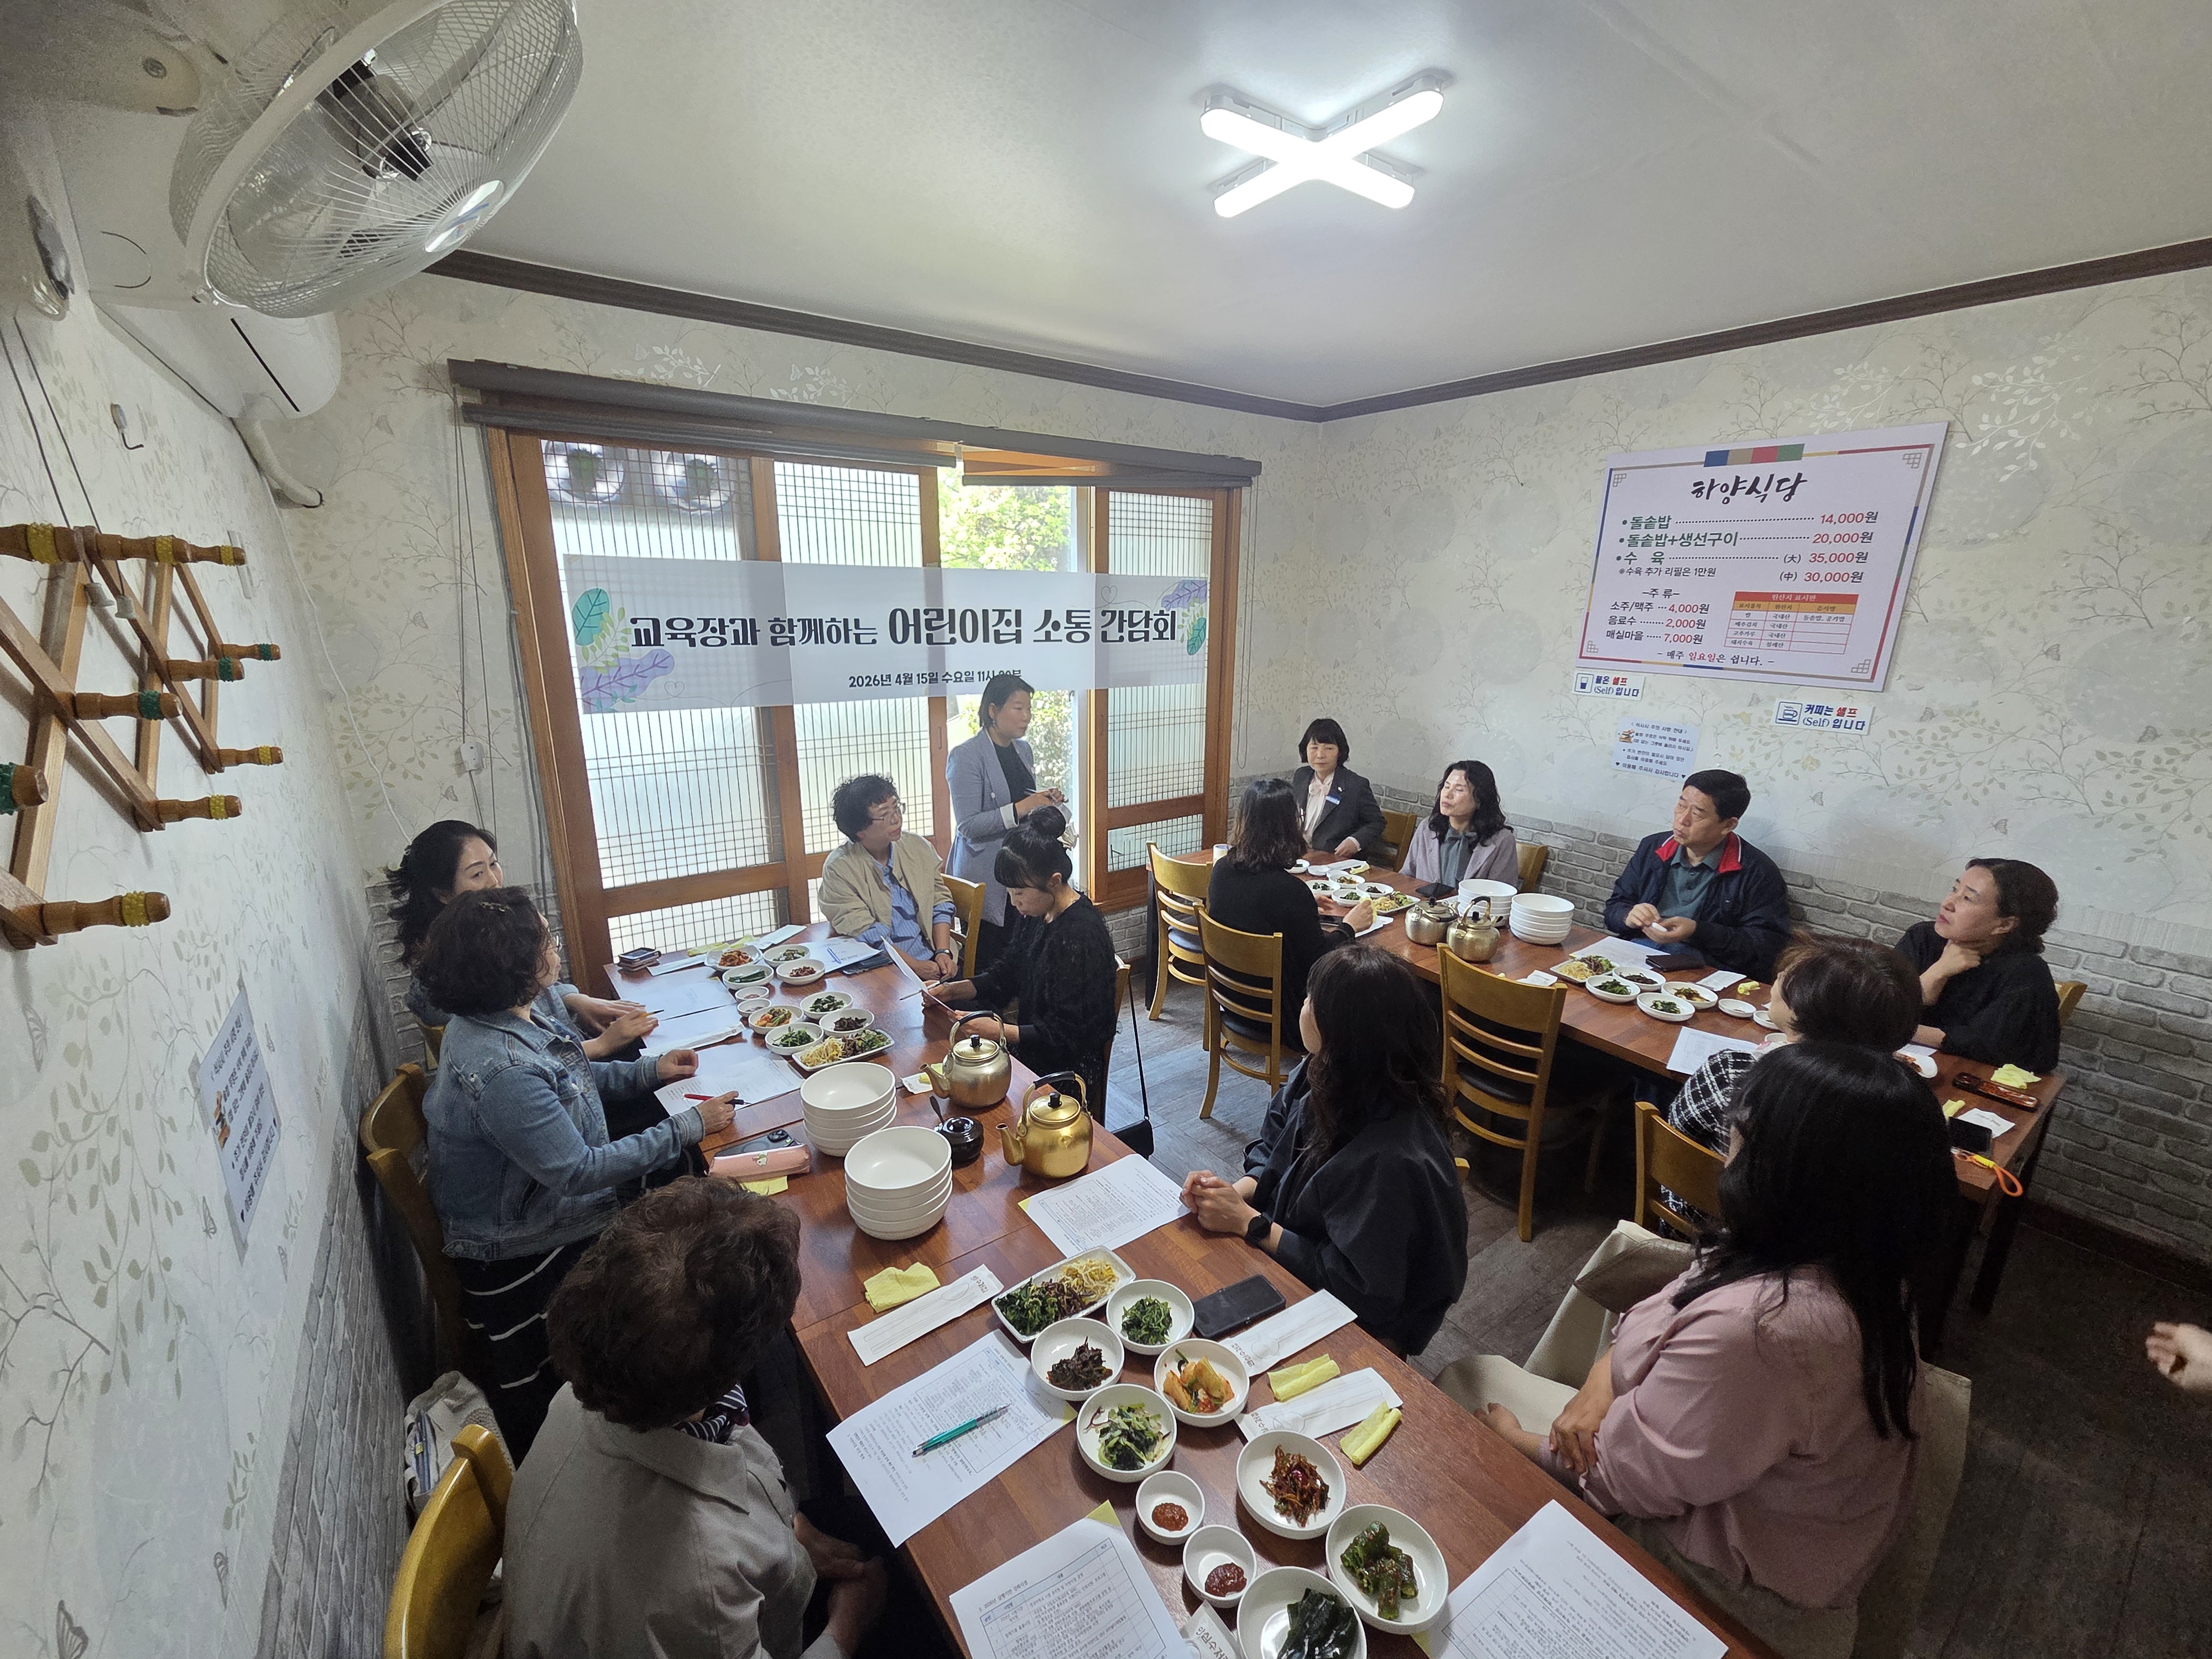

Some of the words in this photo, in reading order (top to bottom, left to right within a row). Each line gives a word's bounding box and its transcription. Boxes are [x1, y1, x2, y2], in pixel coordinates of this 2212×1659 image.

[1691, 472, 1808, 504] 하양식당
[1630, 515, 1672, 530] 돌솥밥
[1820, 511, 1879, 525] 14,000원
[1627, 532, 1739, 547] 돌솥밥+생선구이
[1812, 532, 1874, 545] 20,000원
[1623, 552, 1637, 565] 수
[1651, 551, 1665, 565] 육
[1783, 554, 1802, 565] (大)
[1808, 552, 1869, 564] 35,000원
[1645, 567, 1663, 576] 추가
[1665, 567, 1692, 577] 리필은
[1694, 567, 1717, 577] 1만원
[1780, 571, 1798, 582] (中)
[1803, 571, 1864, 583] 30,000원
[1610, 602, 1653, 612] 소주/맥주
[1668, 603, 1710, 614] 4,000원
[630, 617, 760, 647] 교육장과
[768, 617, 878, 646] 함께하는
[889, 608, 1022, 645] 어린이집
[1033, 609, 1092, 643] 소통
[1100, 609, 1176, 643] 간담회
[1608, 615, 1637, 625] 음료수
[1665, 618, 1706, 629] 2,000원
[1606, 630, 1644, 641] 매실마을
[1663, 633, 1703, 644] 7,000원
[1667, 650, 1684, 659] 매주
[1688, 651, 1726, 663] 일요일은
[1730, 655, 1762, 666] 쉽니다.
[848, 675, 891, 687] 2026년
[895, 673, 914, 685] 4월
[916, 672, 938, 684] 15일
[941, 671, 974, 683] 수요일
[977, 670, 994, 682] 11시
[1613, 676, 1627, 686] 셀프
[1594, 686, 1614, 695] (Self)
[1615, 687, 1639, 697] 입니다
[1804, 704, 1834, 716] 커피는
[1836, 707, 1858, 717] 셀프
[1803, 717, 1830, 727] (Self)
[1832, 718, 1865, 731] 입니다
[1196, 1626, 1229, 1659] 안심수저
